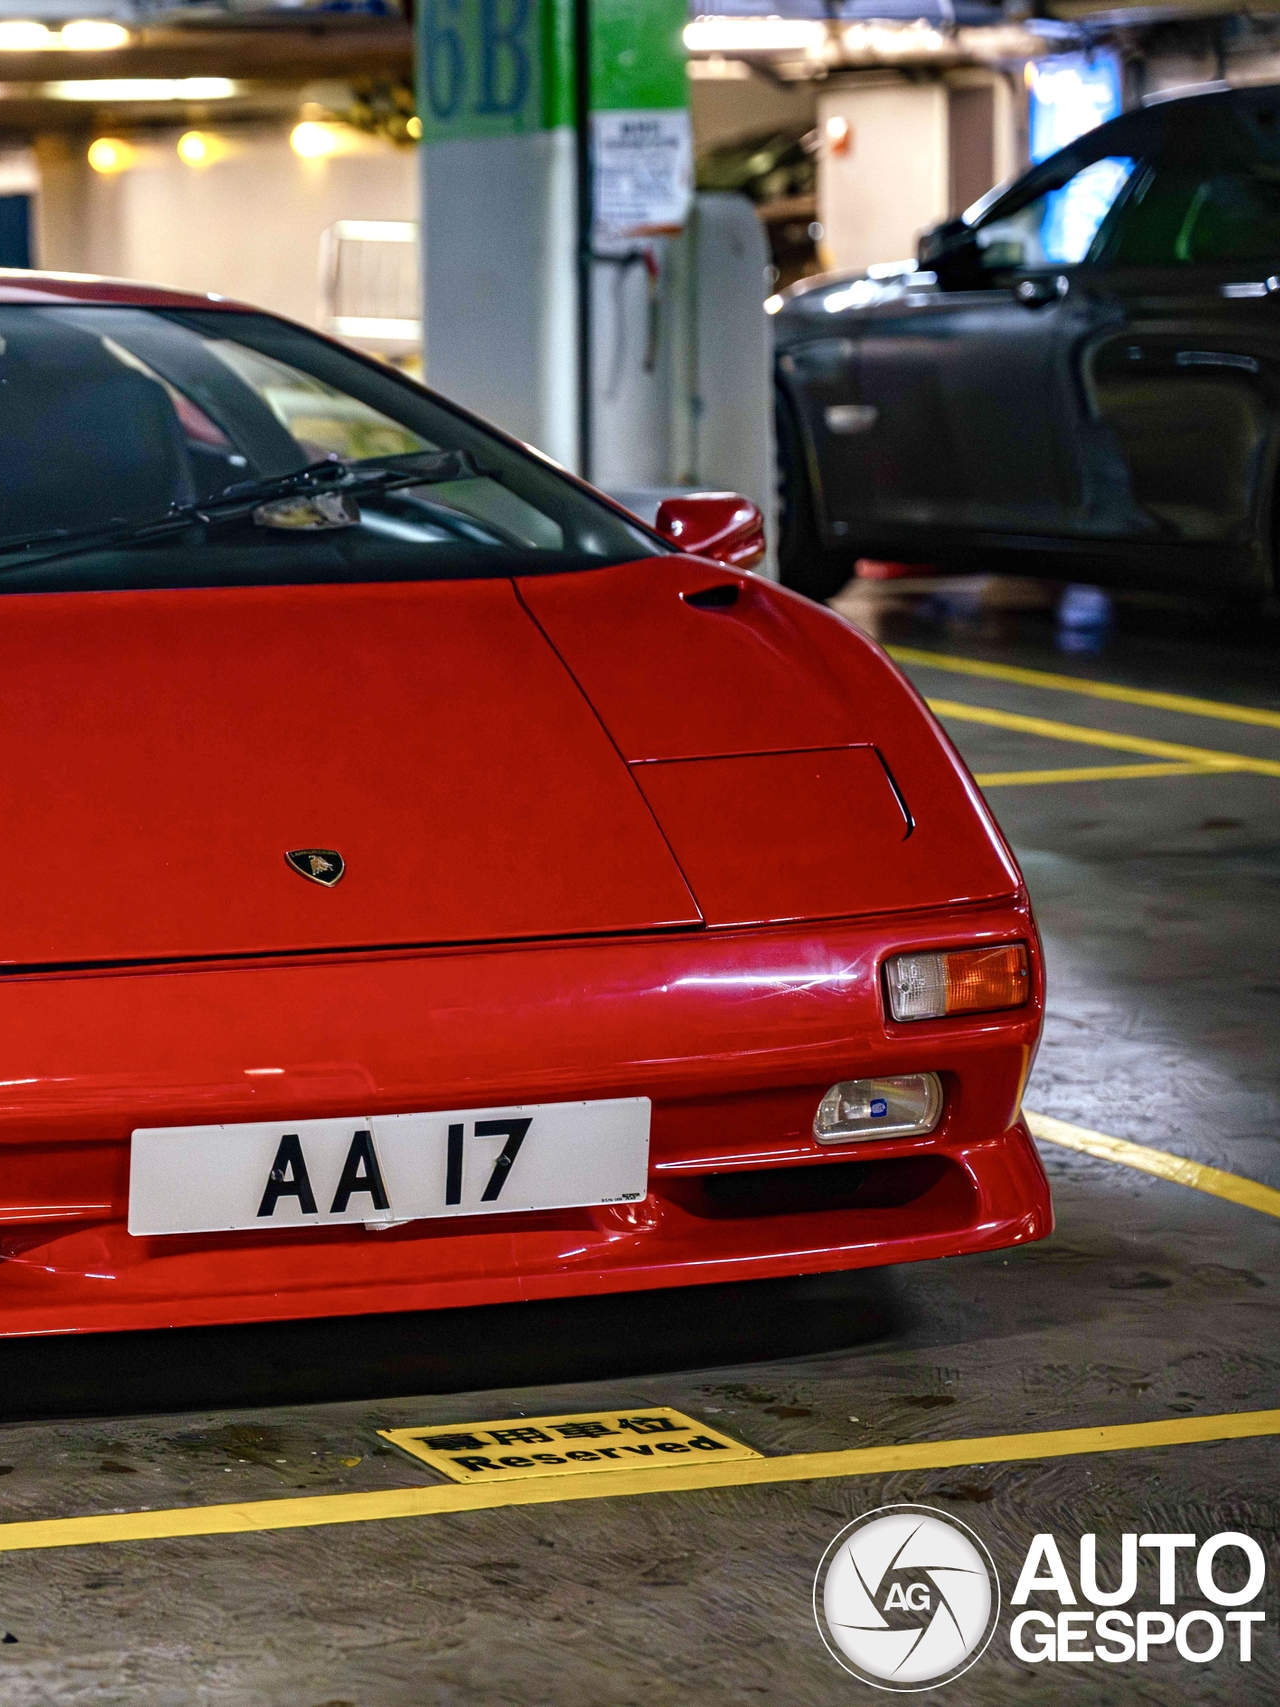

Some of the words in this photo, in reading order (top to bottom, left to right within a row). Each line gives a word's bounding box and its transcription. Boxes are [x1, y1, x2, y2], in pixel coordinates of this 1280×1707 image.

[423, 0, 530, 120] 6B
[257, 1130, 391, 1218] AA
[445, 1117, 534, 1206] 17
[449, 1434, 730, 1472] Reserved
